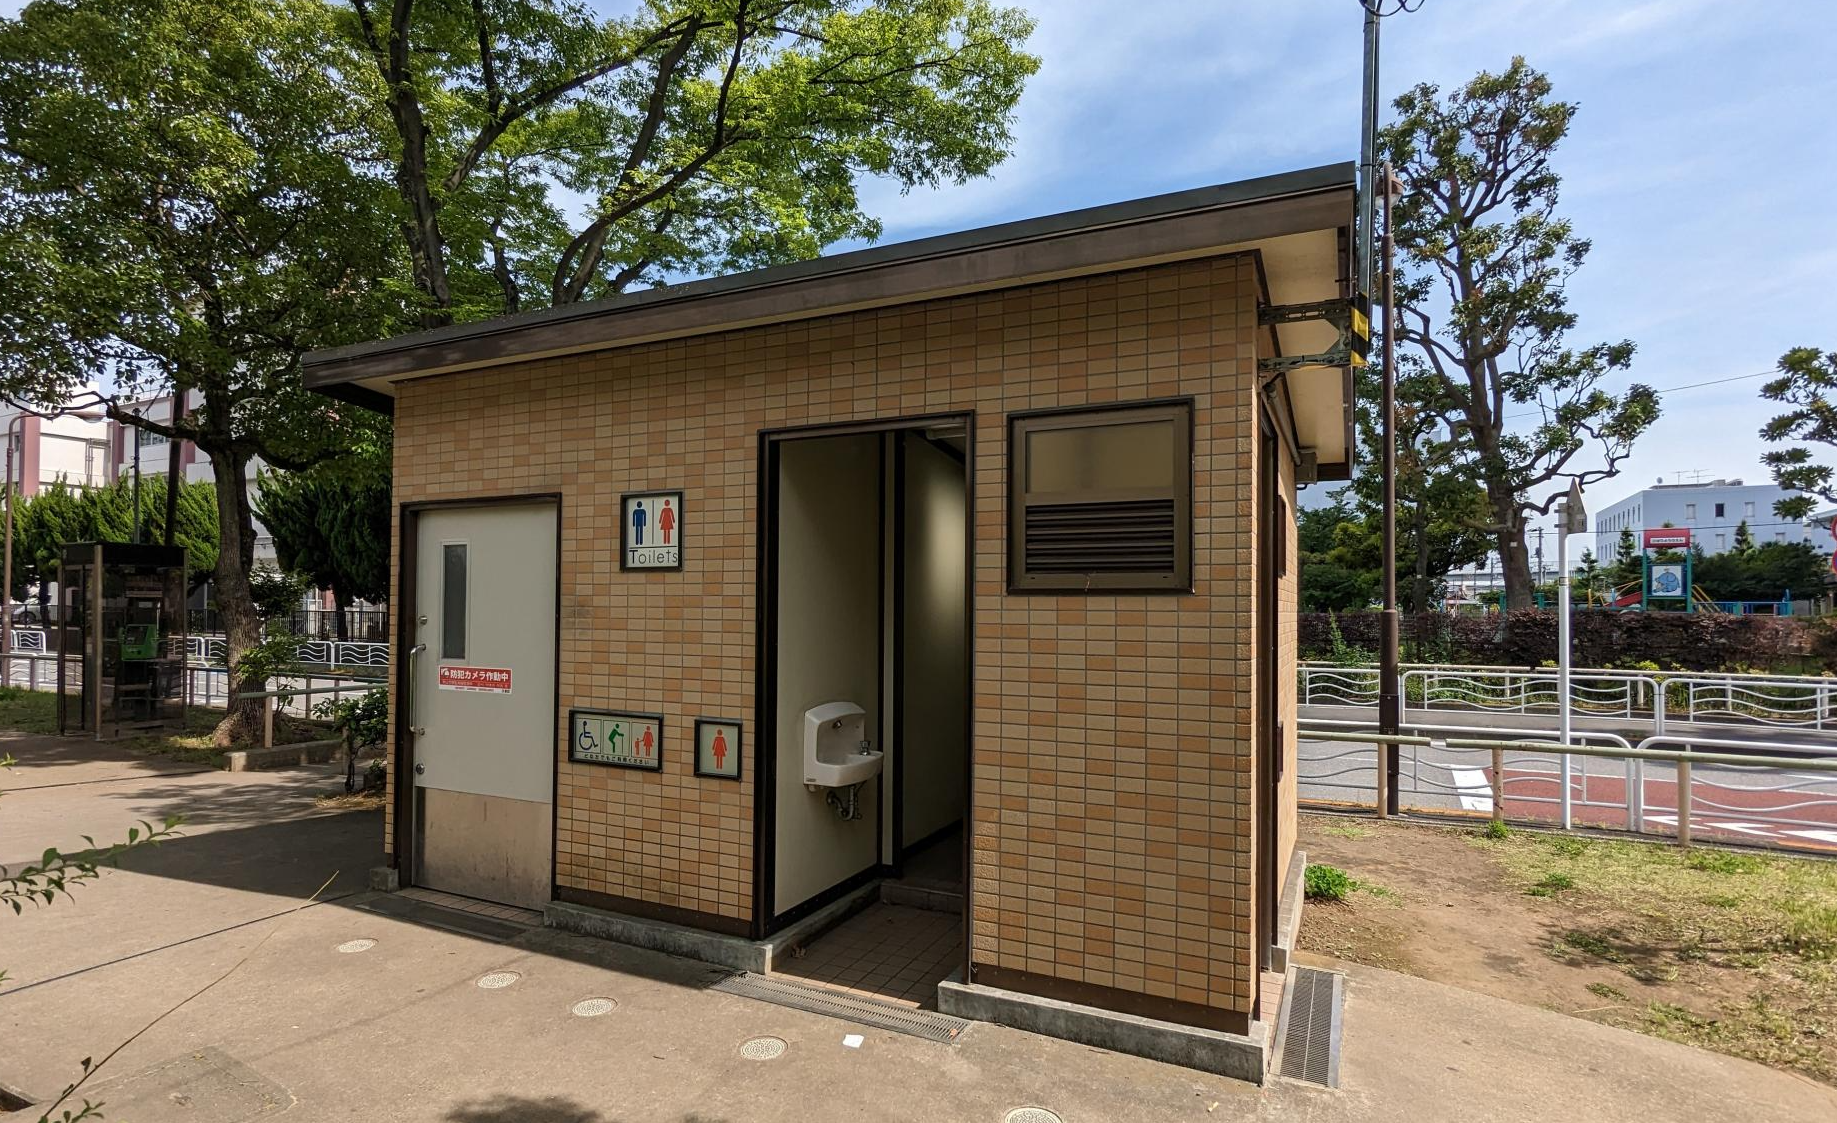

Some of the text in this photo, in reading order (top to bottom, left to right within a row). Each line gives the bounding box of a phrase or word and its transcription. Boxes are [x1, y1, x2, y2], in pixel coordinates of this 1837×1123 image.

[629, 549, 678, 564] Toilets
[450, 669, 508, 682] 防犯カメラ作動中
